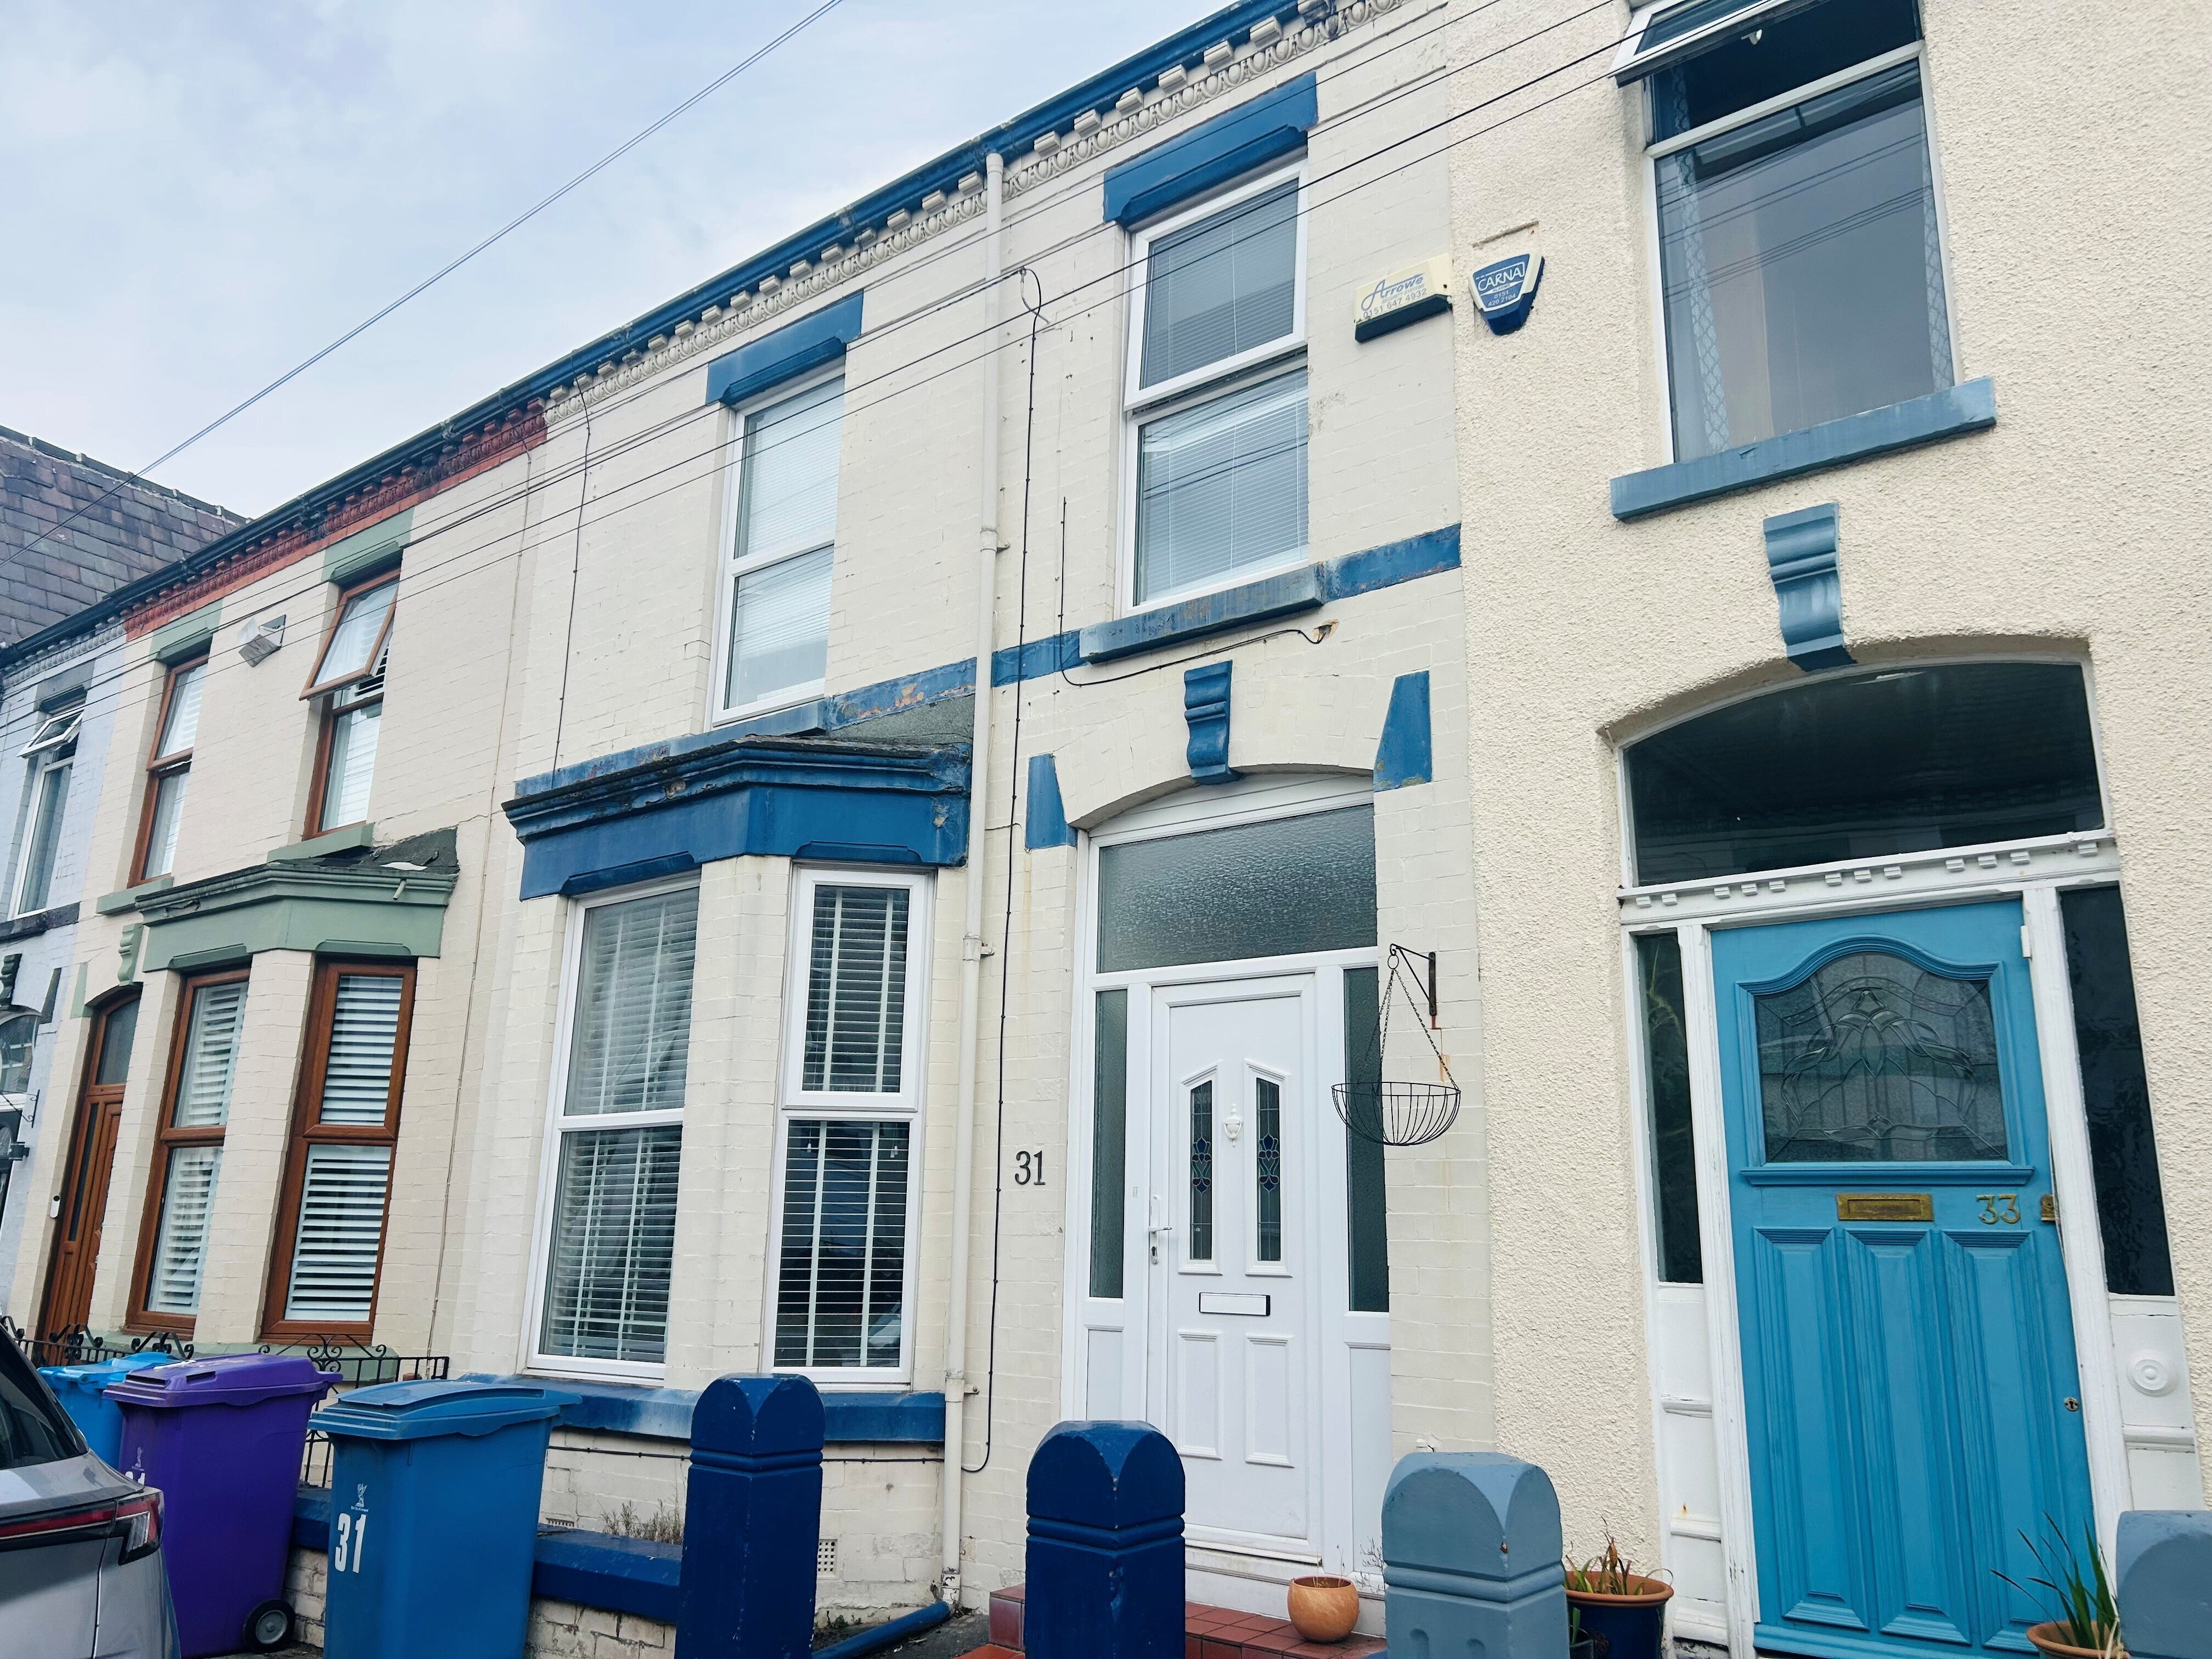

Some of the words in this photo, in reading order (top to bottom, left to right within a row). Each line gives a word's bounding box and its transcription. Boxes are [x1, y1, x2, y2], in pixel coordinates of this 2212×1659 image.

[1361, 274, 1424, 311] Arrowe
[1477, 267, 1525, 291] CARNA
[1494, 290, 1509, 298] 0151
[1363, 306, 1383, 319] 0151
[1387, 298, 1402, 309] 647
[1014, 1150, 1046, 1186] 31
[1976, 1193, 2021, 1224] 33
[335, 1513, 366, 1573] 31
